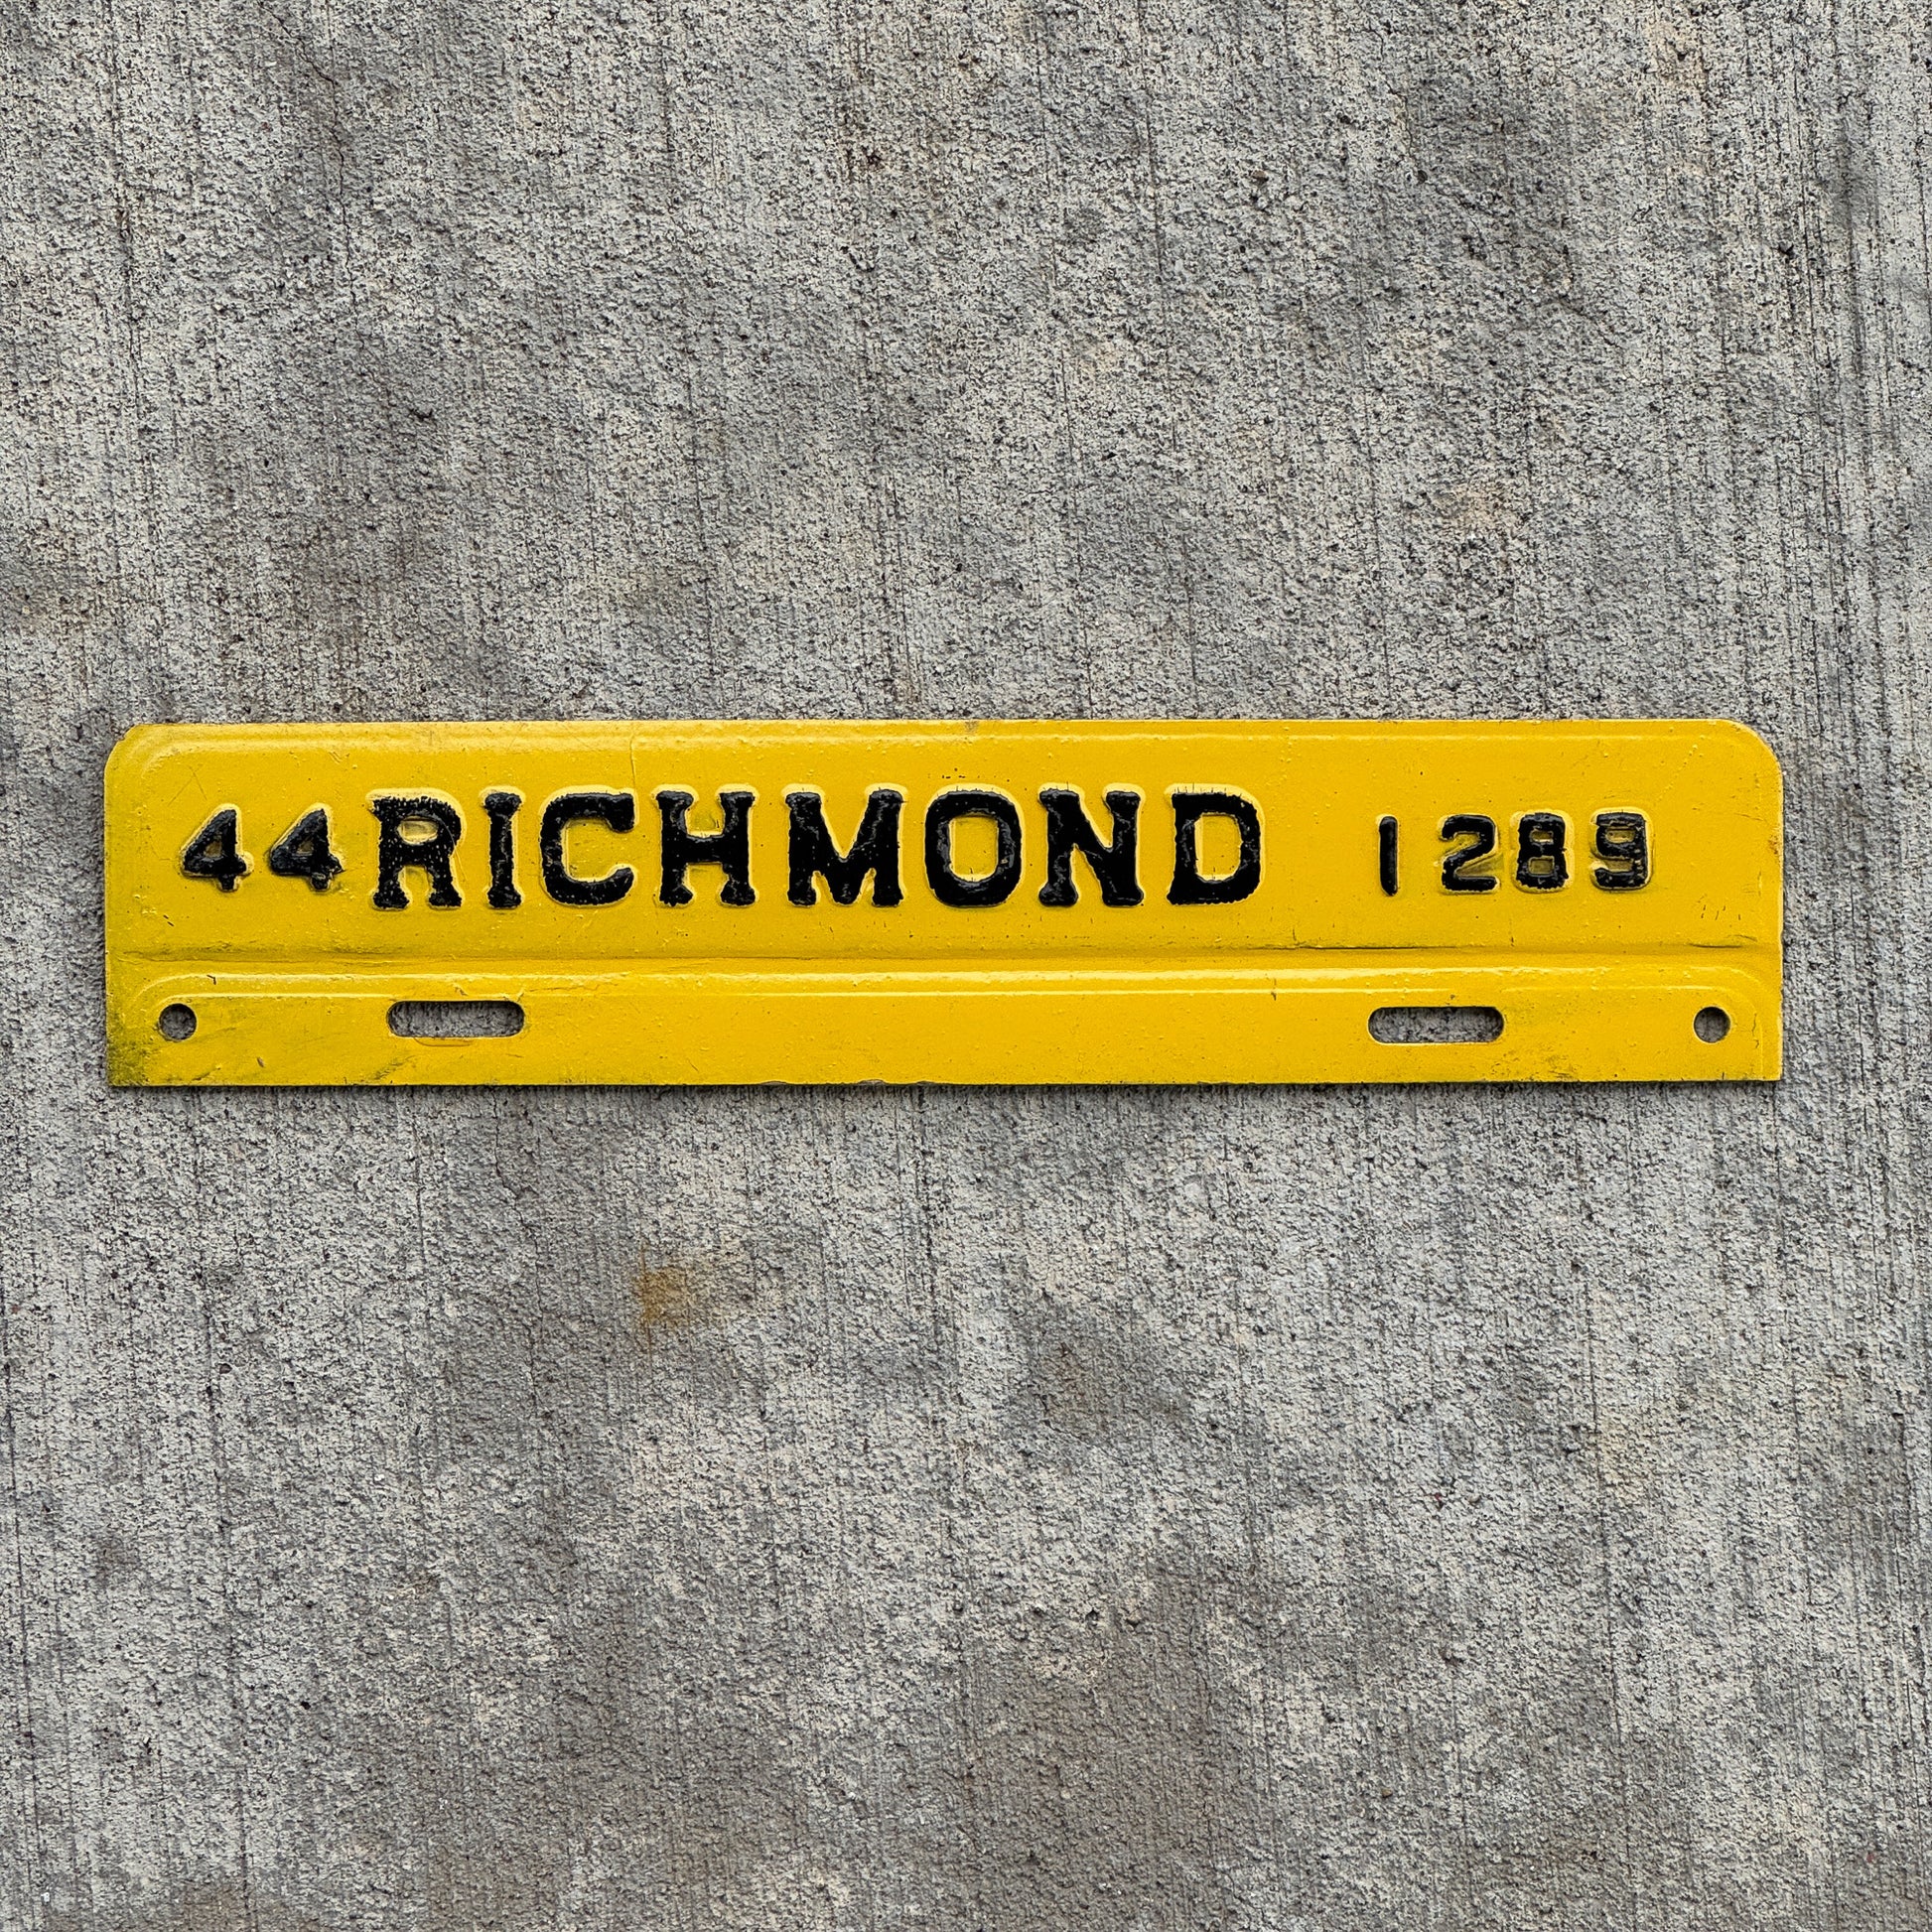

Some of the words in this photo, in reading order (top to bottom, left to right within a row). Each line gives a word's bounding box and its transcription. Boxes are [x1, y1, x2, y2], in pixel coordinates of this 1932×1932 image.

[181, 807, 345, 894] 44
[370, 787, 1262, 910] RICHMOND
[1377, 810, 1649, 897] 1289
